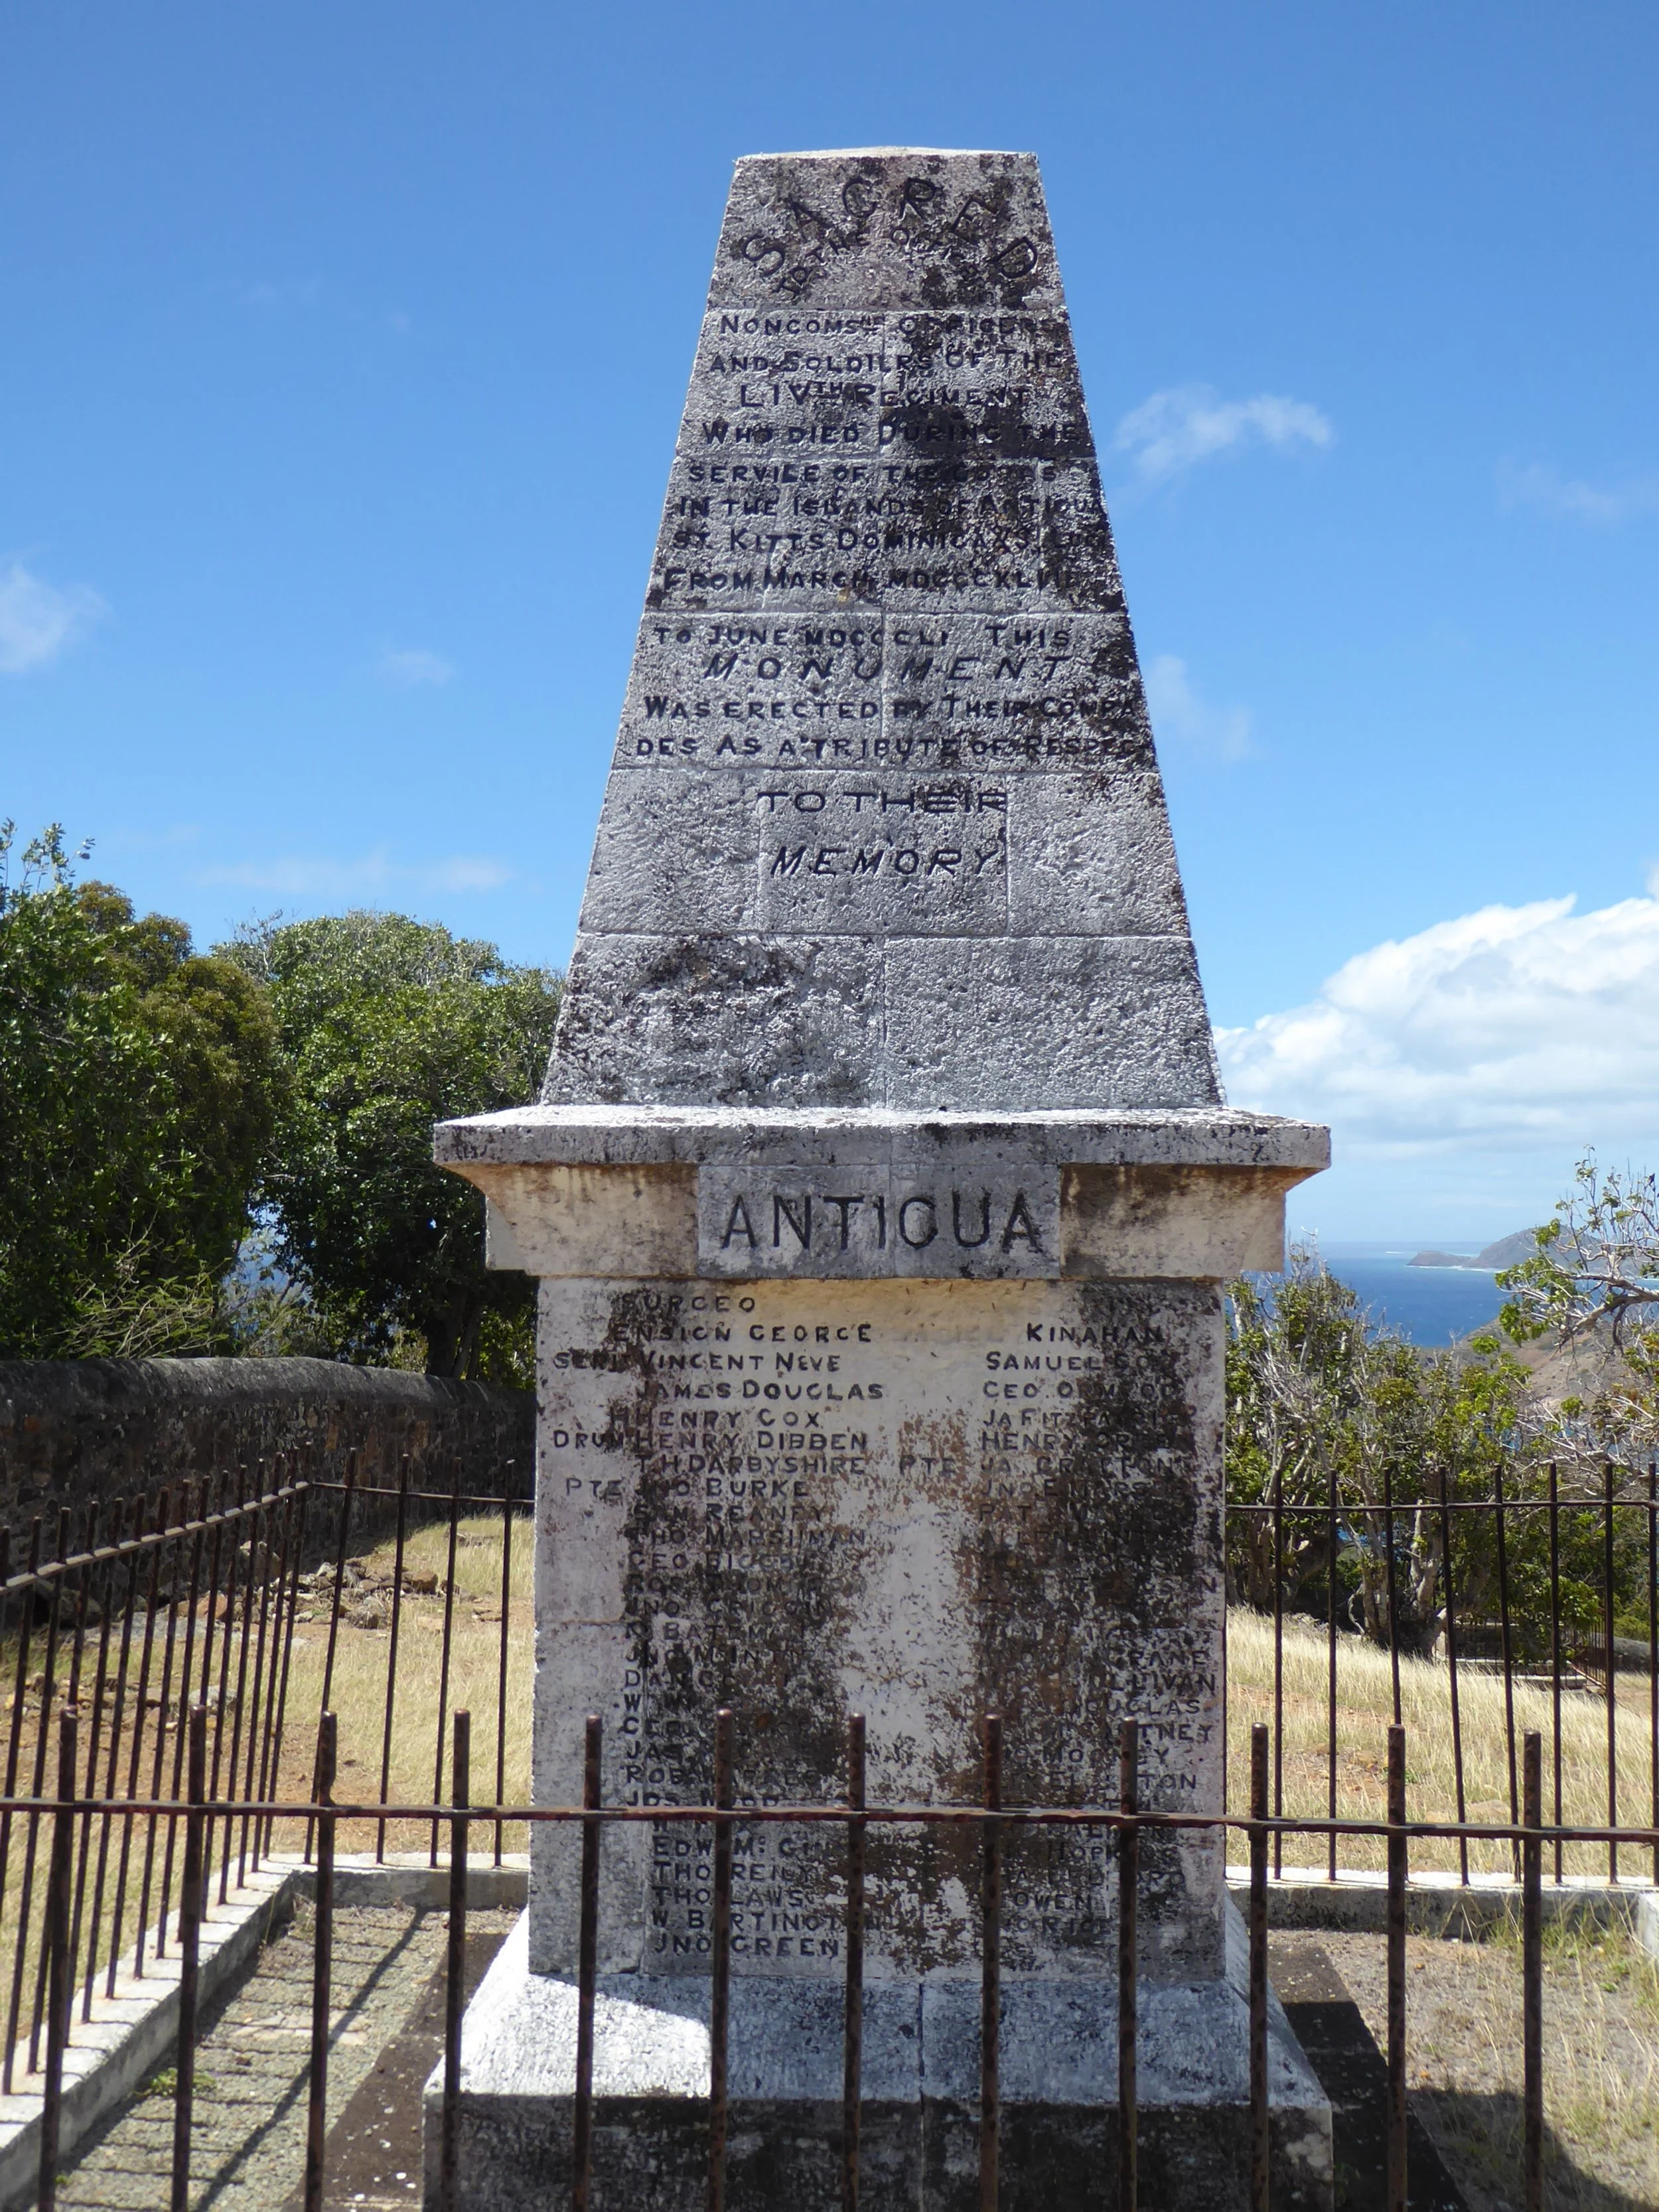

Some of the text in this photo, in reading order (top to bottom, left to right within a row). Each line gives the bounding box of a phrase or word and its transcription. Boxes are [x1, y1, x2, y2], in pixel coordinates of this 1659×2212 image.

[742, 177, 1037, 279] SACRED
[709, 349, 1064, 373] AND SOLDIERS OF THE
[854, 383, 1029, 407] REGIMENT
[702, 421, 1080, 447] WHO DIED DURING THE
[688, 464, 820, 483] SERVICE
[833, 465, 867, 482] OF
[883, 465, 939, 483] THE
[678, 496, 711, 517] IN
[720, 498, 779, 516] THE
[794, 497, 926, 516] ISLANDS
[938, 497, 973, 516] OF
[730, 528, 824, 552] KITTS
[664, 567, 752, 590] FROM
[764, 566, 873, 590] MARCH
[652, 625, 691, 645] TO
[706, 625, 788, 646] JUNE
[985, 625, 1070, 649] THIS
[702, 653, 1071, 682] MONUMENT
[643, 695, 711, 720] WAS
[722, 700, 878, 720] ERECTED
[941, 692, 1031, 719] THEIR
[636, 737, 709, 757] DES
[715, 735, 762, 756] AS
[803, 737, 960, 759] TRIBUTE
[972, 738, 1008, 756] OF
[757, 790, 1007, 814] TO THEIR
[770, 846, 1001, 877] MEMORY
[1027, 1322, 1165, 1343] KINAHAN
[641, 1351, 764, 1371] VINCENT
[776, 1352, 841, 1372] NEVE
[985, 1351, 1102, 1371] SAMUEL
[637, 1378, 884, 1401] JAMES DOUGLAS
[758, 1408, 820, 1428] COX
[553, 1430, 868, 1450] DRUM HENRY DIBBEN
[981, 1431, 1078, 1451] HENRY
[689, 1454, 865, 1475] DARBYSHIRE
[565, 1477, 623, 1498] PTE
[705, 1477, 809, 1498] BURKE
[652, 1836, 712, 1857] EDW
[653, 1861, 711, 1882] THO
[652, 1886, 712, 1907] THO
[1014, 1892, 1092, 1911] OWEN
[653, 1932, 839, 1957] JNO GREEN
